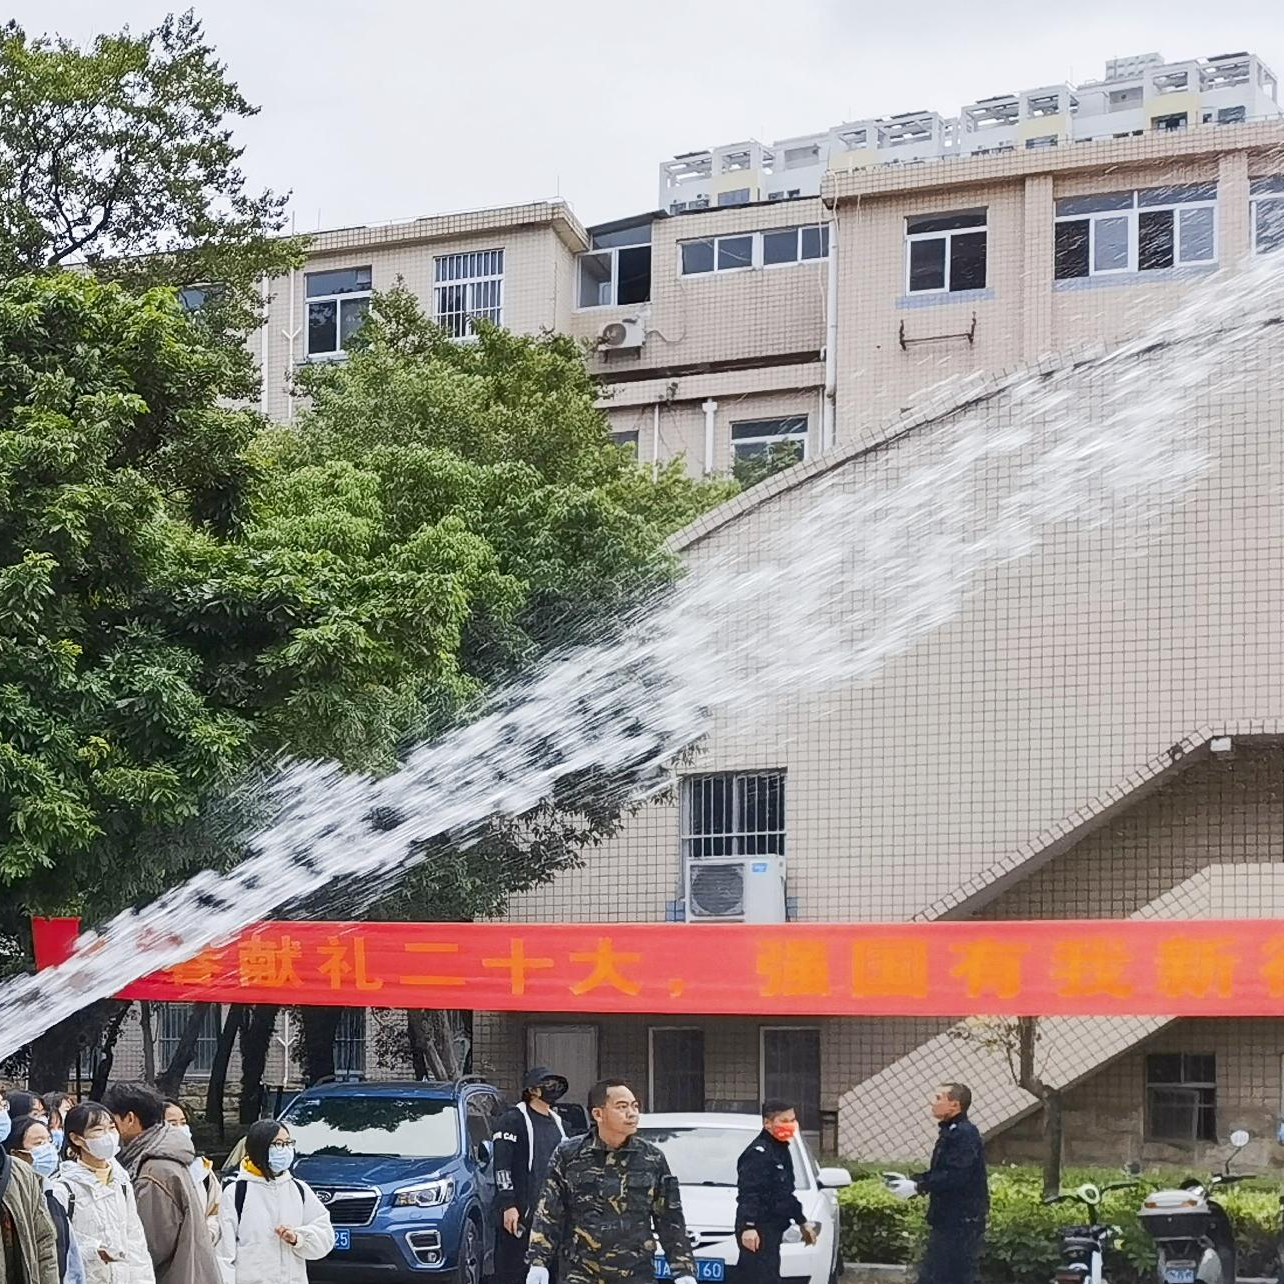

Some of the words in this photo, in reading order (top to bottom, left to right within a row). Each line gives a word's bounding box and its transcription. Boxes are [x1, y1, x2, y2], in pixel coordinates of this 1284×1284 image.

[88, 934, 1284, 999] 春献礼二十大，强国有我新
